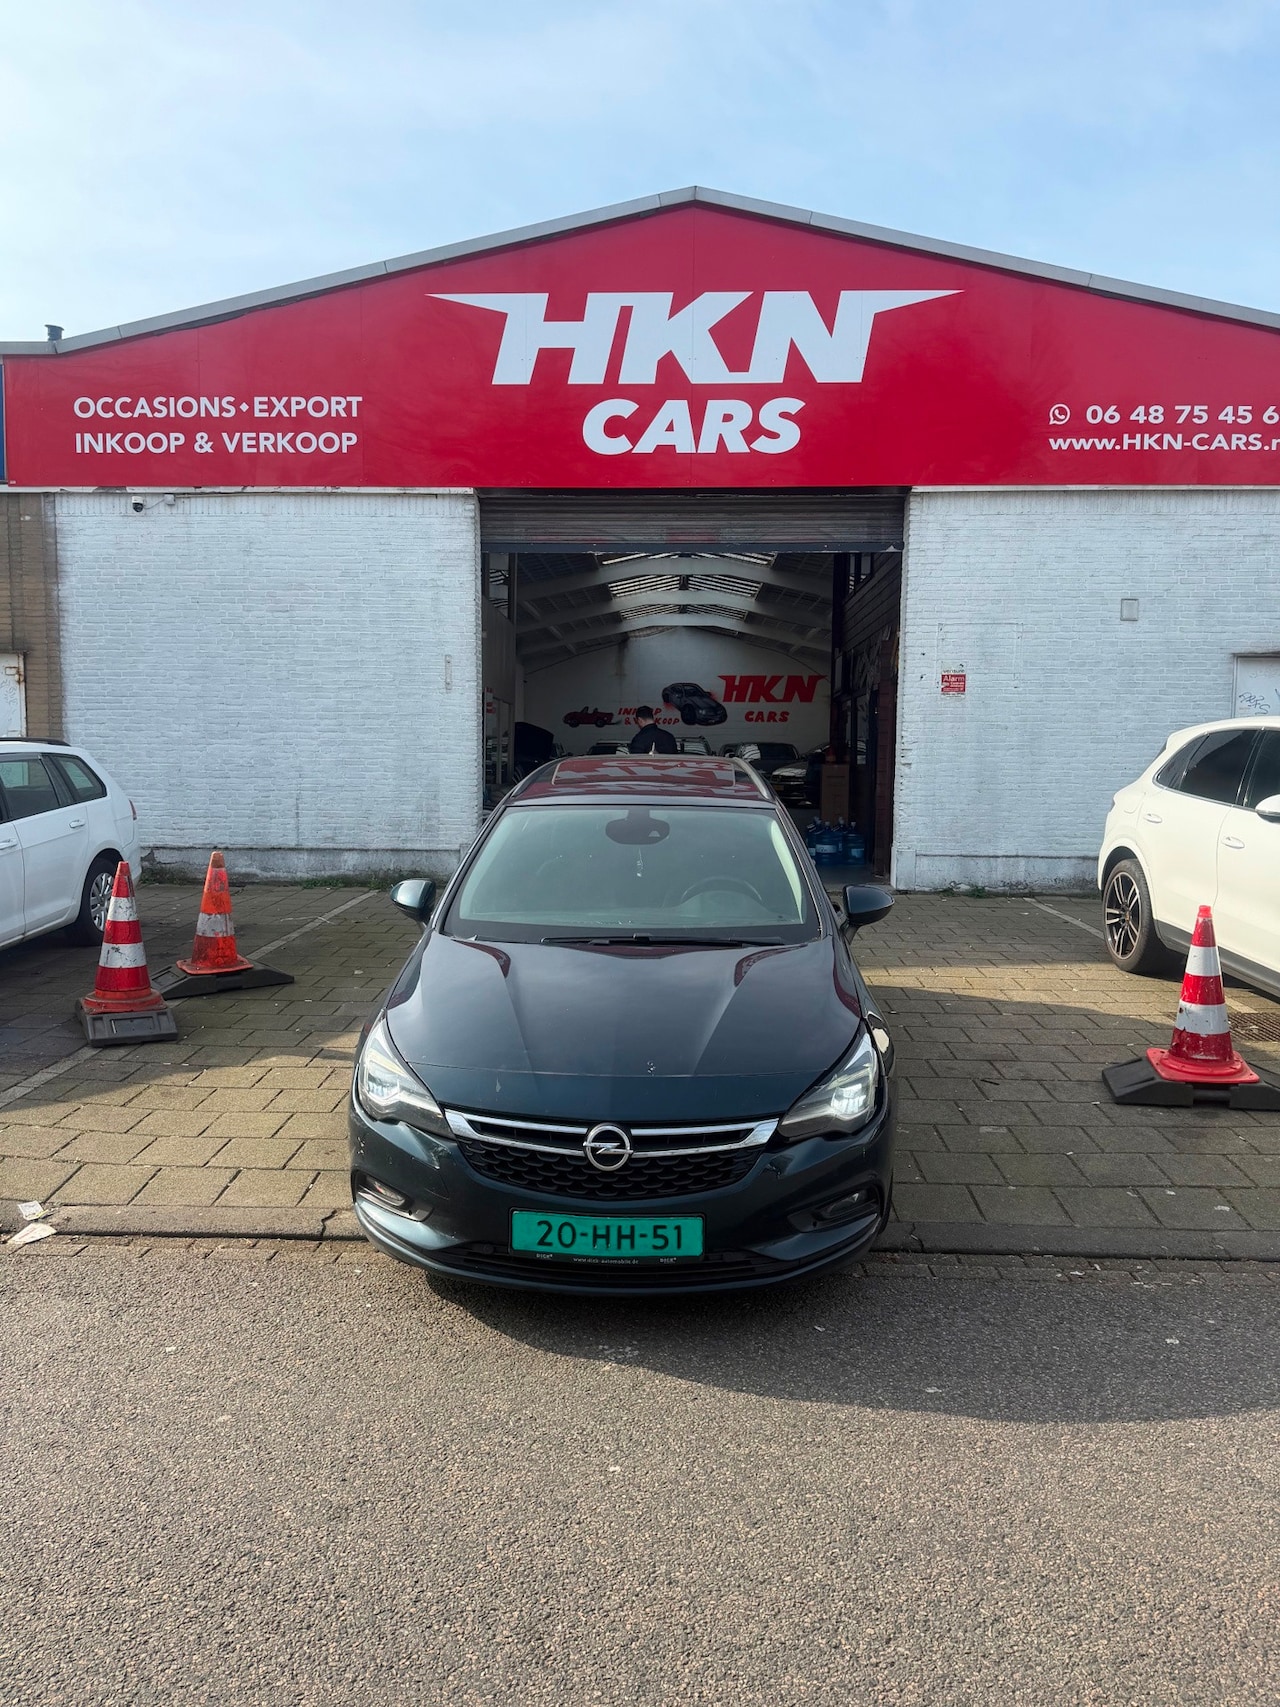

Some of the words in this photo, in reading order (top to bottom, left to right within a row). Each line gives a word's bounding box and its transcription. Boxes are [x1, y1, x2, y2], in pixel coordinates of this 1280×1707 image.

[423, 290, 965, 385] HKN
[73, 395, 236, 419] OCCASIONS
[253, 395, 363, 418] EXPORT
[1086, 404, 1121, 424] 06
[1129, 404, 1165, 424] 48
[1174, 404, 1209, 424] 75
[1217, 404, 1253, 424] 45
[582, 397, 806, 455] CARS
[75, 432, 186, 454] INKOOP
[193, 432, 214, 454] &
[222, 432, 358, 454] VERKOOP
[718, 675, 828, 703] HKN
[744, 711, 790, 722] CARS
[536, 1220, 682, 1251] 20-HH-51
